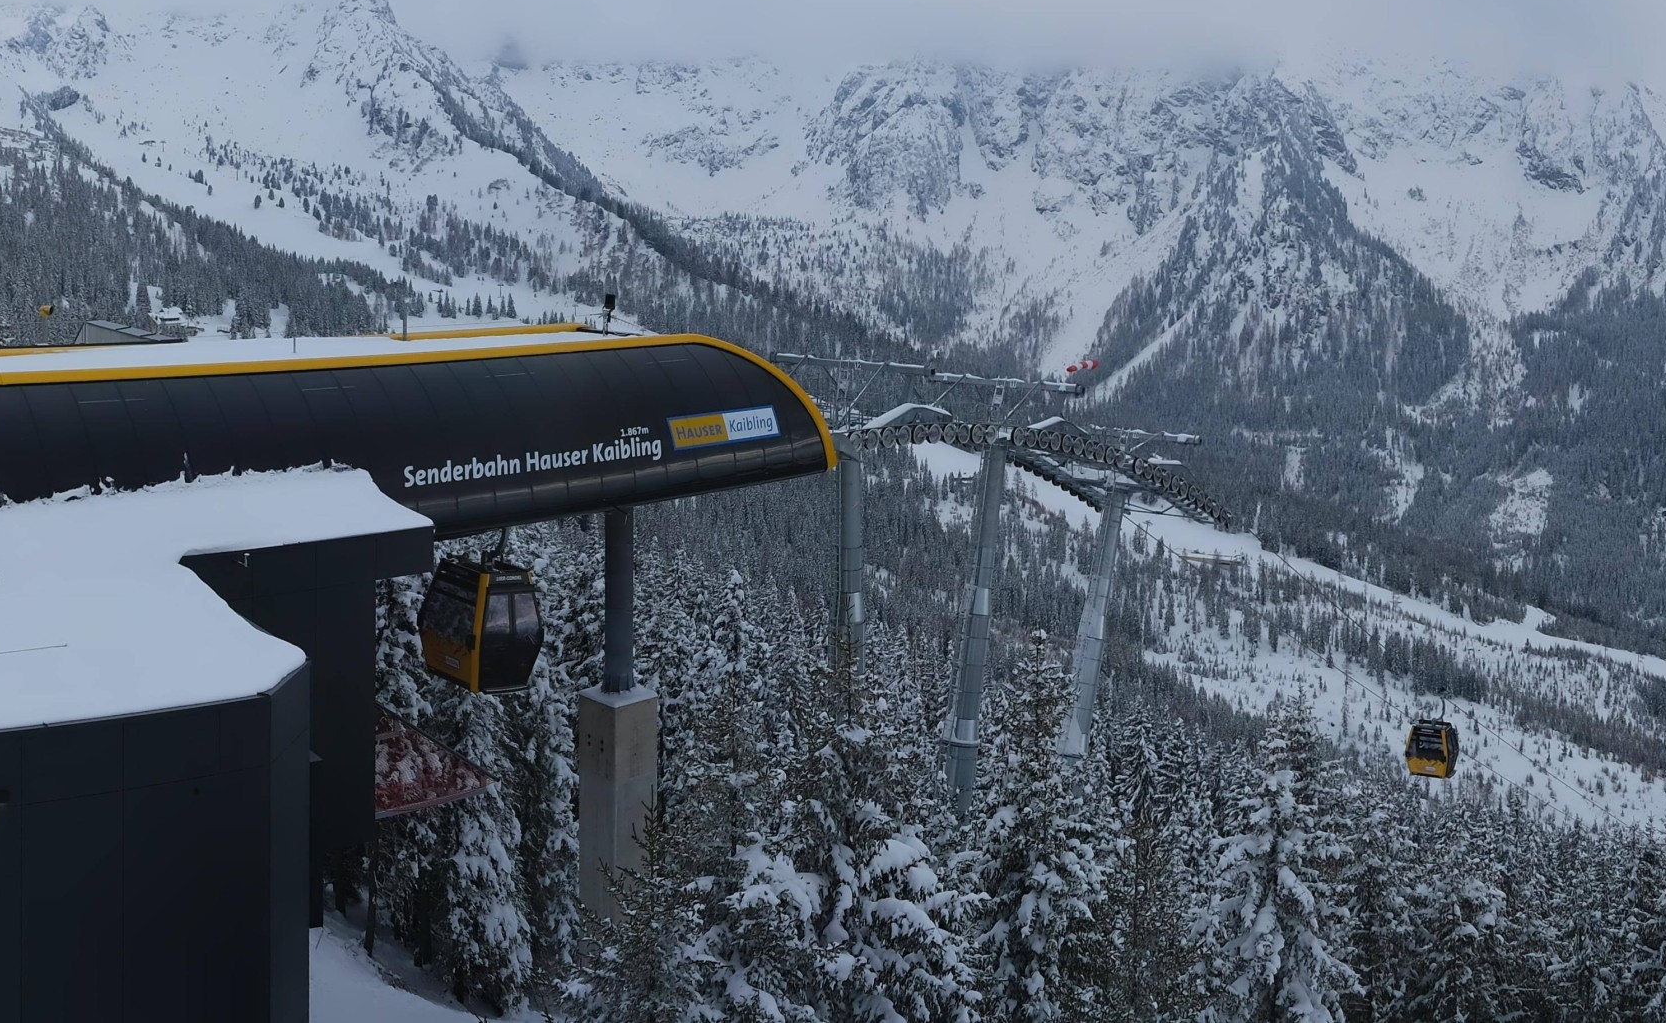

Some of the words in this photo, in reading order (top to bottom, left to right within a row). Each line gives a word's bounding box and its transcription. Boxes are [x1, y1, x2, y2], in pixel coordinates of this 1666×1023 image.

[620, 426, 650, 437] 1.867m
[675, 424, 723, 440] HAUSER
[728, 415, 773, 433] Kaibling
[403, 454, 521, 488] Senderbahn
[525, 448, 588, 472] Hauser
[592, 438, 662, 461] Kaibling
